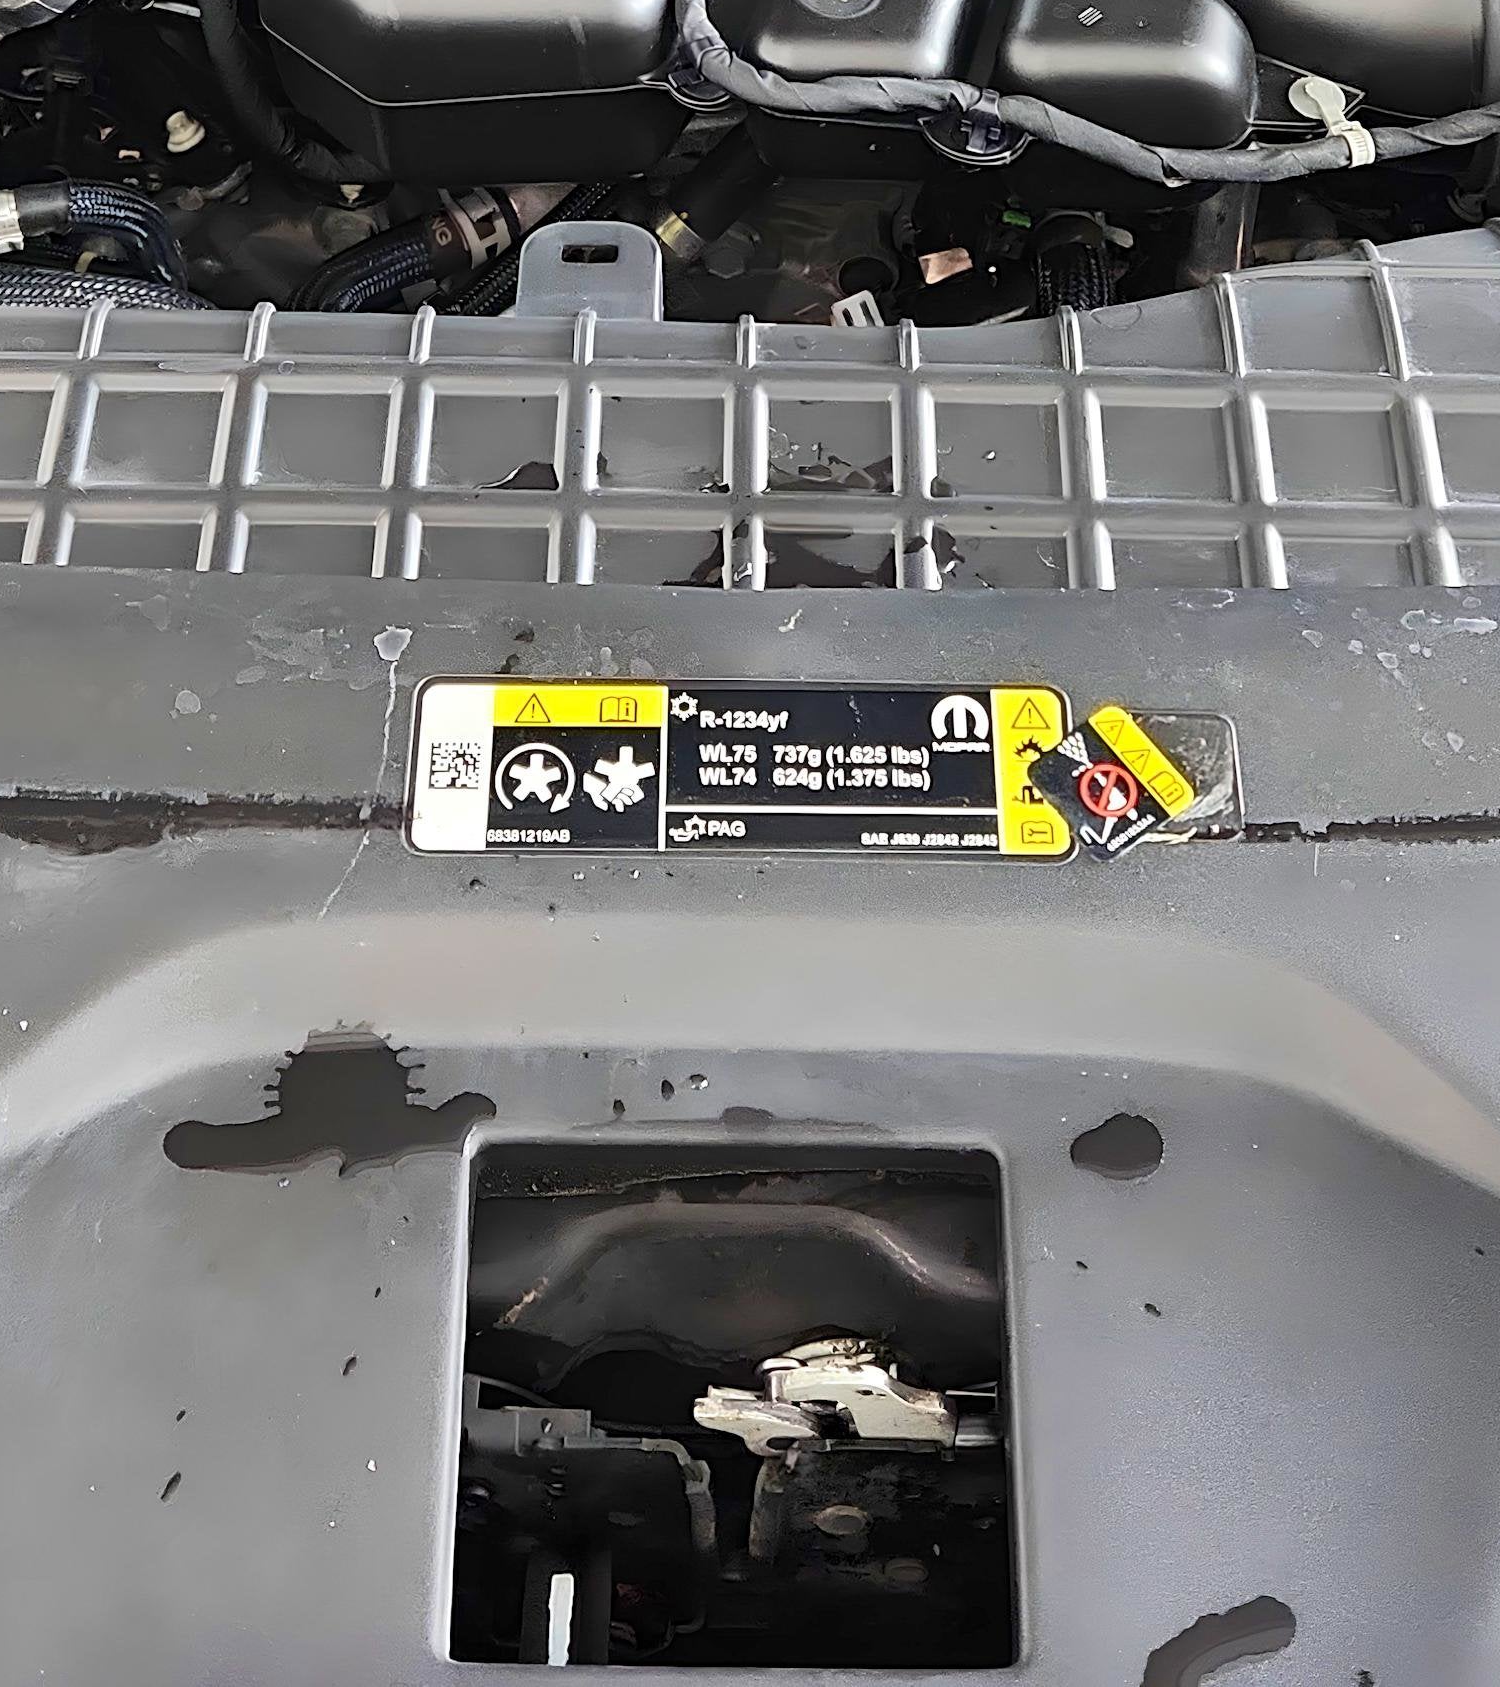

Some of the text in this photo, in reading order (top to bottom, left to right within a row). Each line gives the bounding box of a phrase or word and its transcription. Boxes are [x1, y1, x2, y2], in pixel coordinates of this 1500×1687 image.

[700, 709, 789, 733] R-1234yf
[699, 743, 930, 769] WL75 737g (1.625 lbs)
[699, 767, 931, 792] WL74 624g (1.375 lbs)
[707, 820, 747, 838] PAG
[861, 832, 889, 846] SAE
